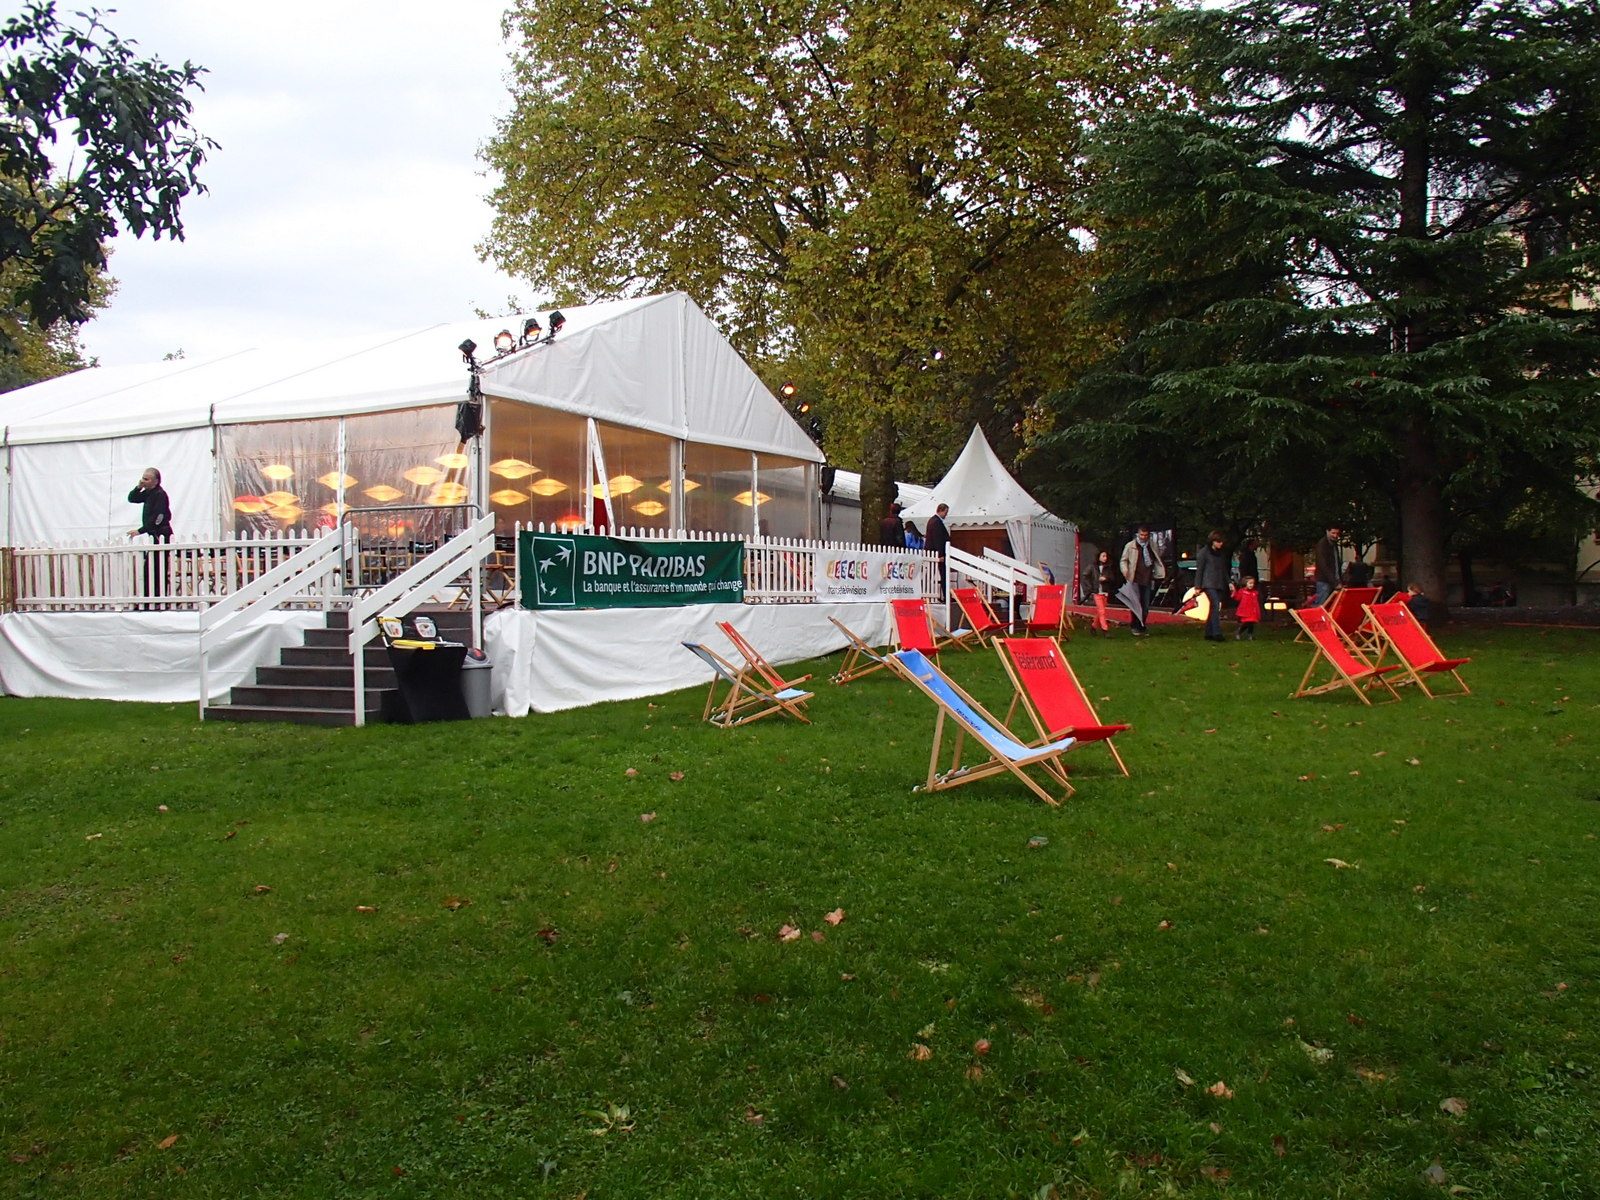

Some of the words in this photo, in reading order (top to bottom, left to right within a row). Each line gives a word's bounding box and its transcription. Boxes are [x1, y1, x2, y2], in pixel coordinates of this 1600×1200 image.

[583, 551, 626, 575] BNP
[629, 554, 705, 577] PARIBAS
[583, 580, 593, 593] La
[594, 580, 622, 596] banque
[622, 582, 630, 593] et
[630, 580, 669, 593] l'assurance
[670, 581, 684, 593] d'un
[684, 580, 708, 592] monde
[717, 578, 743, 592] change
